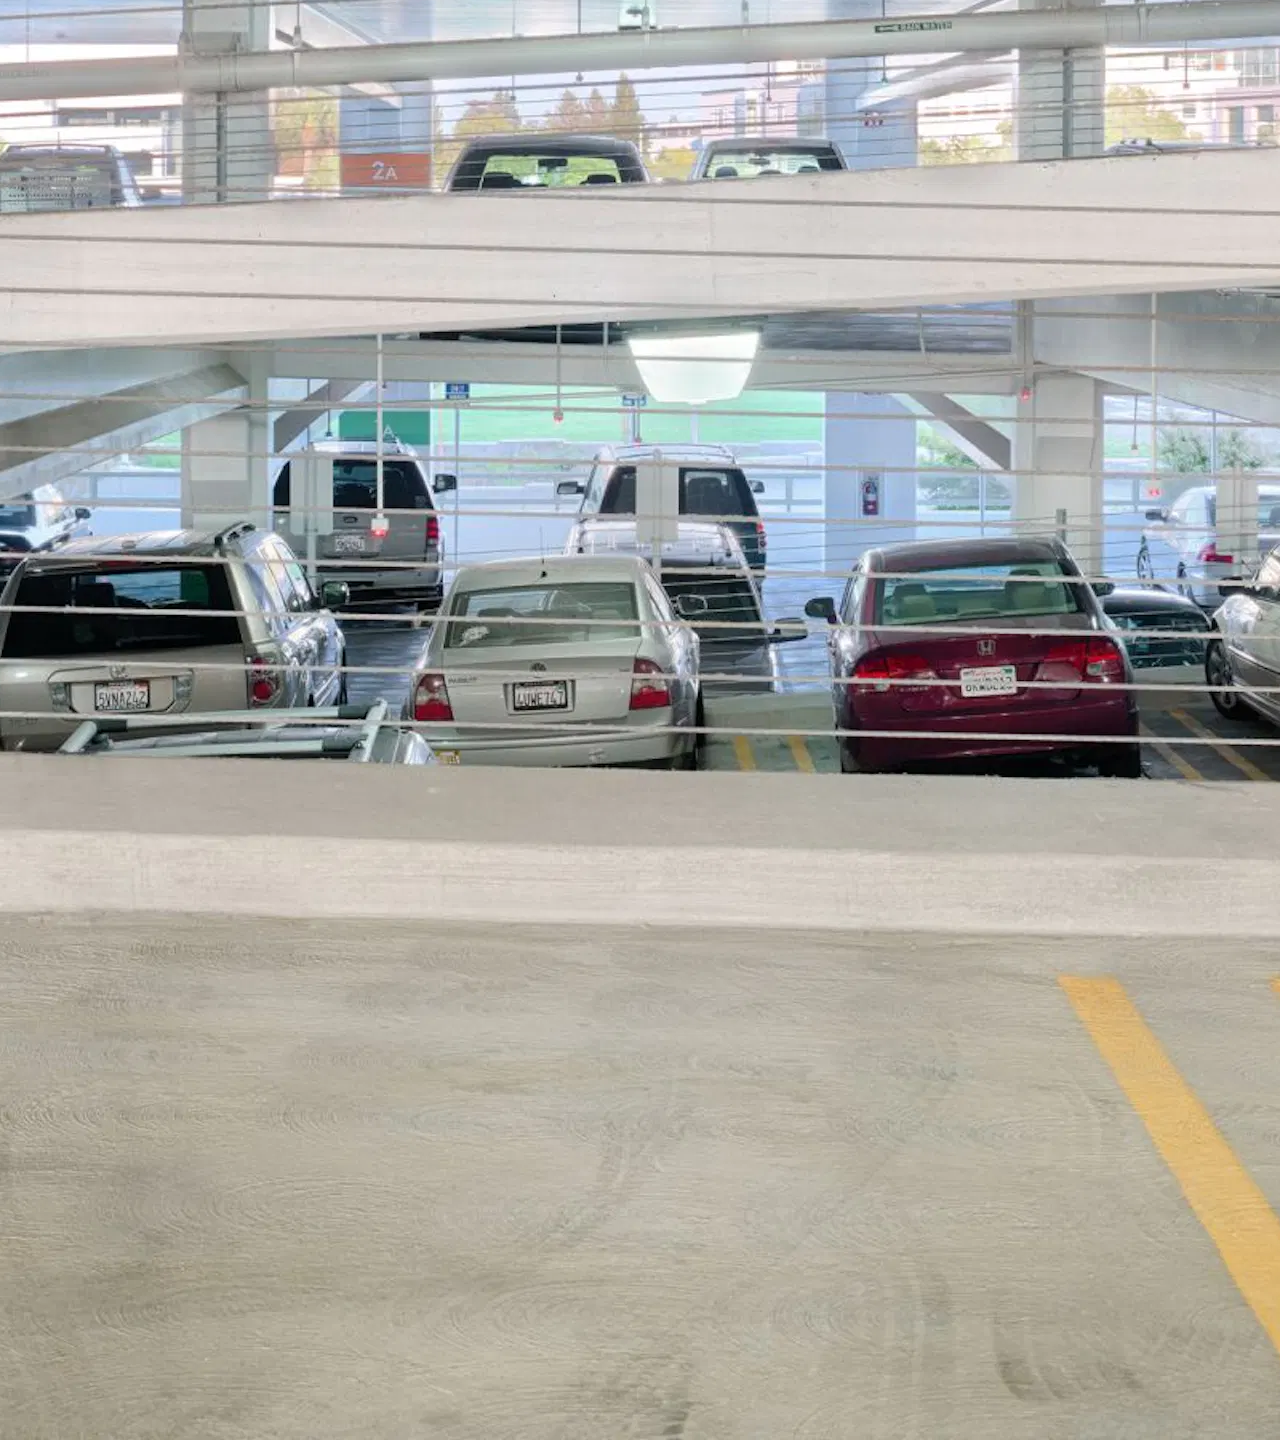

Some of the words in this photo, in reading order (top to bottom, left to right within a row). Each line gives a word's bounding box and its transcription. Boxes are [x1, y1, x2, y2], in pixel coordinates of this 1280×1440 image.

[901, 23, 921, 32] RAIN
[923, 21, 952, 31] WATER
[371, 160, 398, 180] 2A
